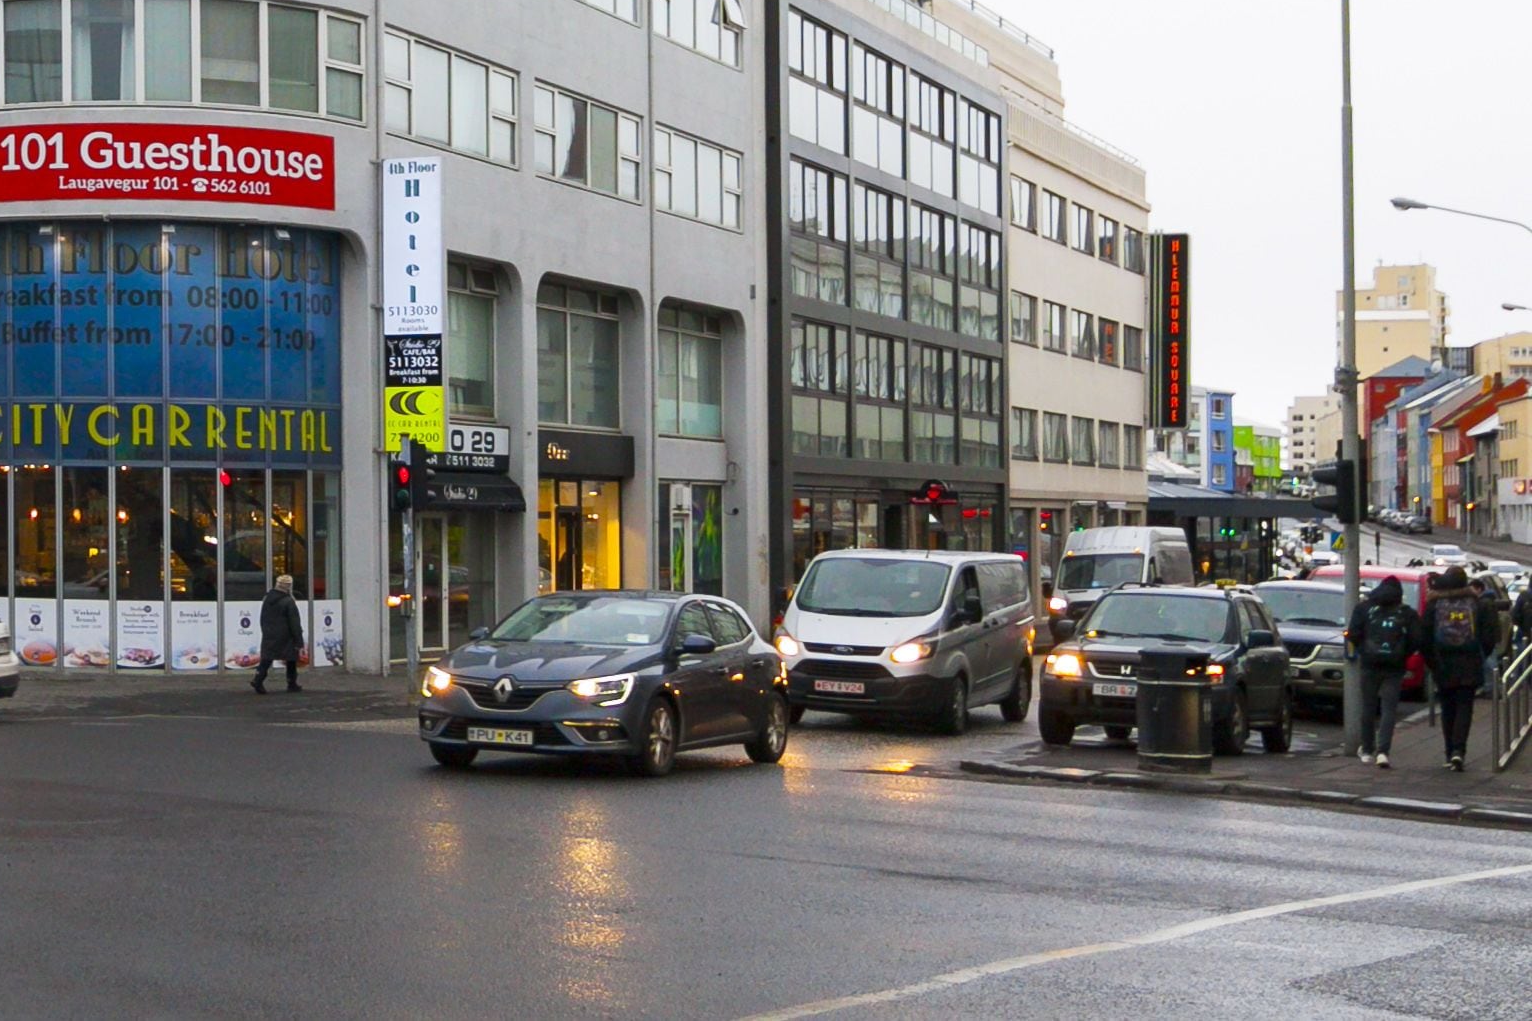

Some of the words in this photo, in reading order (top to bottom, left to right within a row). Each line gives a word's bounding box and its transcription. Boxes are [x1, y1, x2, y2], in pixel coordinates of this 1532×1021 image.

[0, 132, 68, 171] 101
[80, 131, 323, 181] Guesthouse
[389, 161, 405, 174] 4th
[408, 161, 436, 174] Floor
[58, 175, 149, 192] Laugavegur
[153, 176, 179, 191] 101
[211, 179, 237, 194] 562
[239, 181, 272, 197] 6101
[404, 179, 421, 303] Hotel
[56, 230, 202, 276] Floor
[216, 228, 335, 287] Hotel
[104, 282, 173, 307] from
[187, 285, 259, 310] 08:00
[280, 290, 333, 317] 11:00
[388, 305, 438, 317] 5113030
[1, 320, 78, 346] Buffet
[85, 320, 152, 346] from
[163, 323, 235, 348] 17:00
[257, 325, 316, 352] 21:00
[389, 356, 439, 368] 5113032
[87, 404, 193, 448] CAR
[206, 404, 333, 453] RENTAL
[471, 431, 495, 453] 29
[452, 455, 469, 466] 511
[472, 456, 495, 467] 3032
[477, 729, 496, 741] PU
[505, 731, 529, 743] K41
